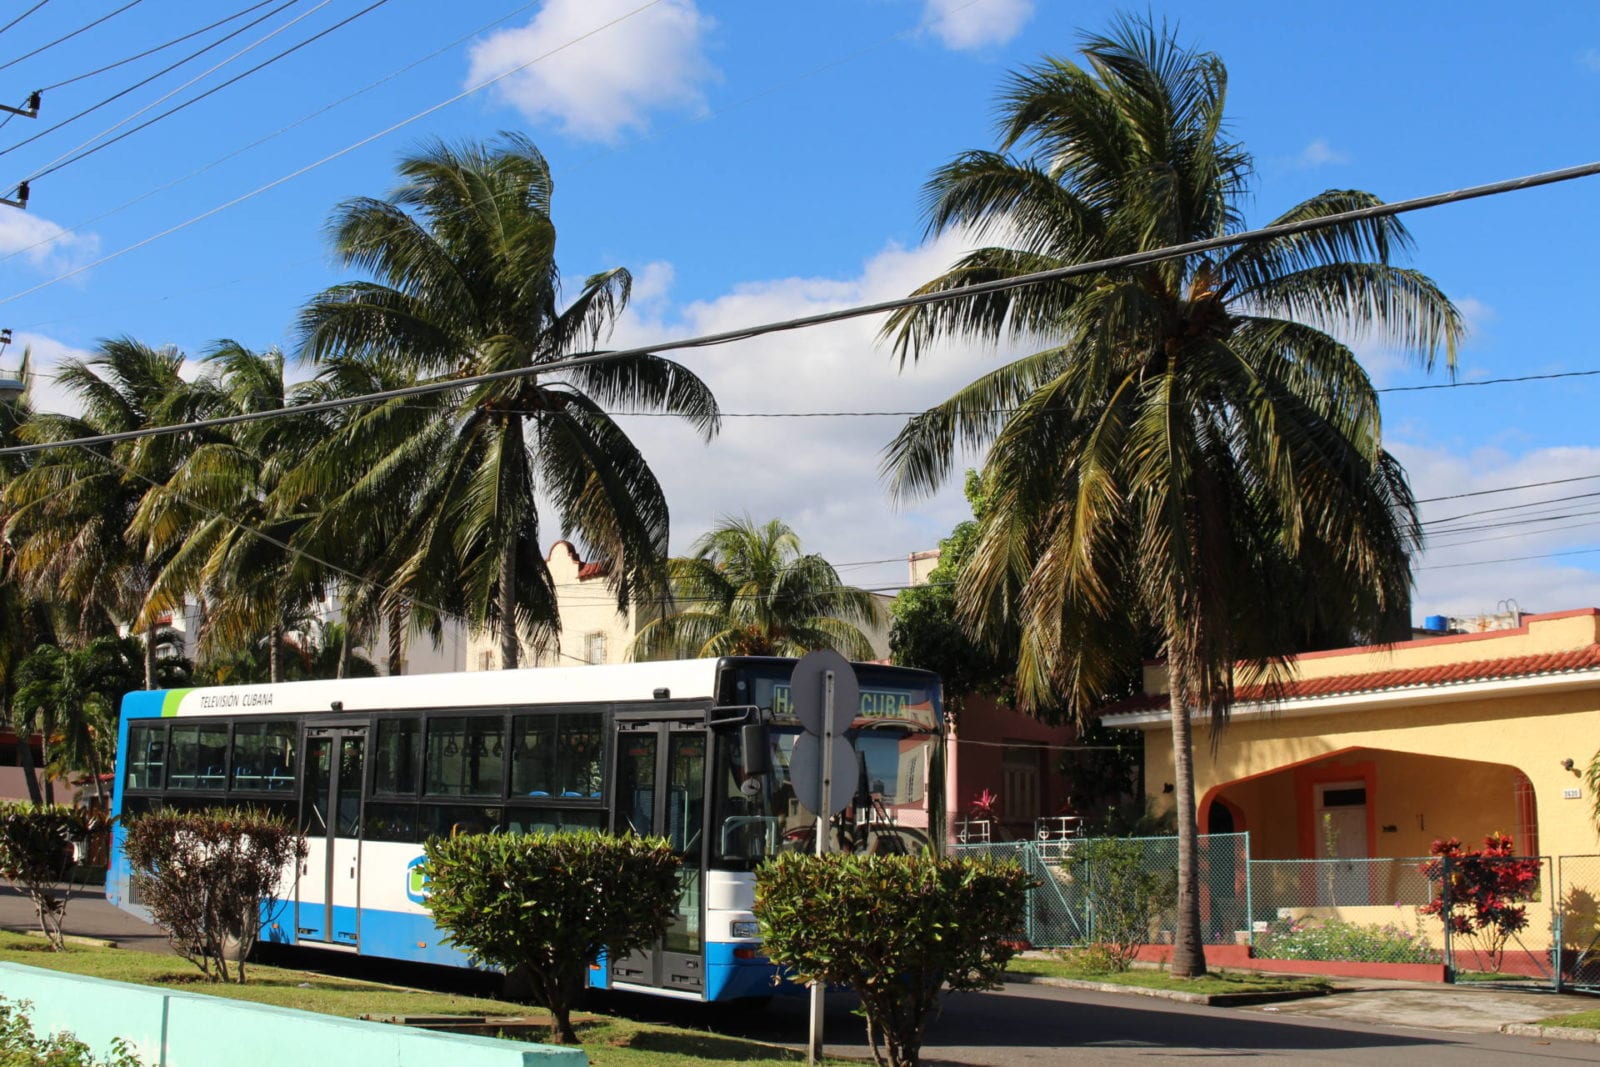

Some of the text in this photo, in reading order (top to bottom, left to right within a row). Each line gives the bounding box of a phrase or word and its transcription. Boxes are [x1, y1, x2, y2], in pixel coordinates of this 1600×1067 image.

[201, 692, 273, 708] TELEVISIÓN CUBANA
[861, 693, 907, 719] CUBA
